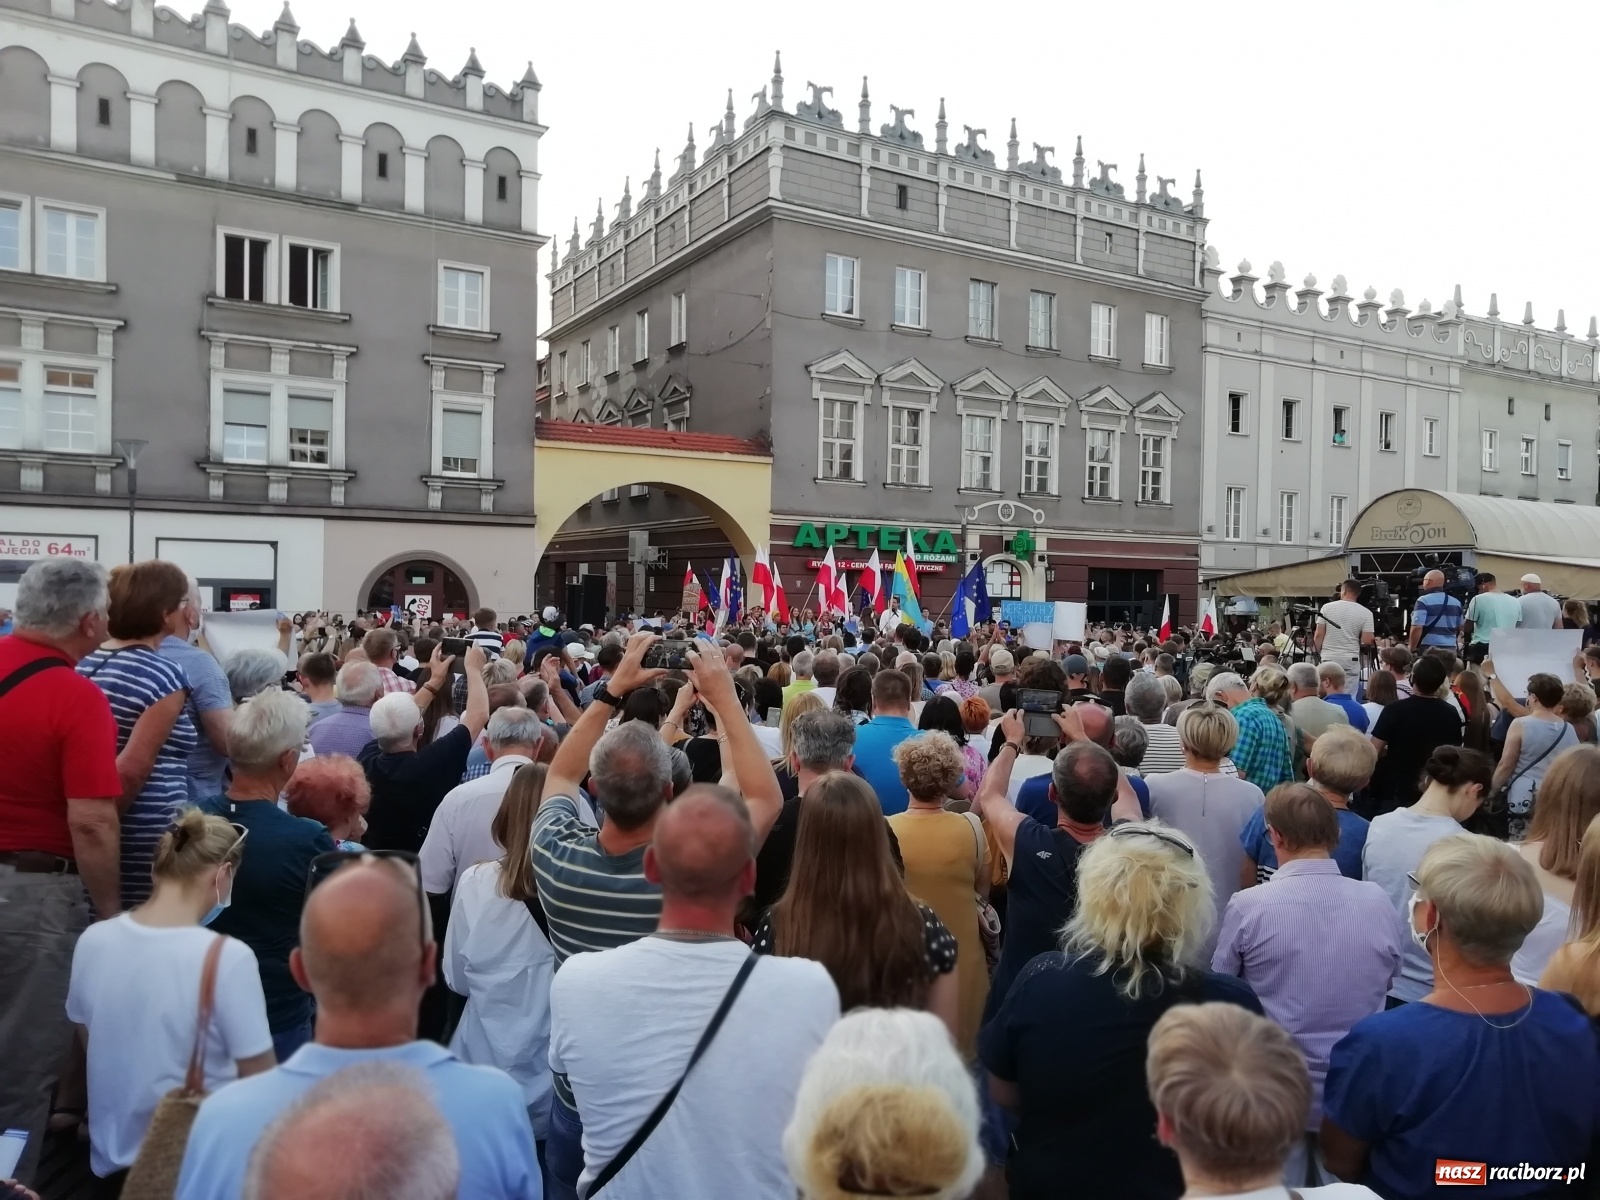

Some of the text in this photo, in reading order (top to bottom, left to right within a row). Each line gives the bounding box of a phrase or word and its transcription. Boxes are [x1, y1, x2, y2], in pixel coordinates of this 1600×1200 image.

[792, 522, 958, 554] APTEKA
[21, 539, 41, 547] DO
[1036, 850, 1053, 859] 4F
